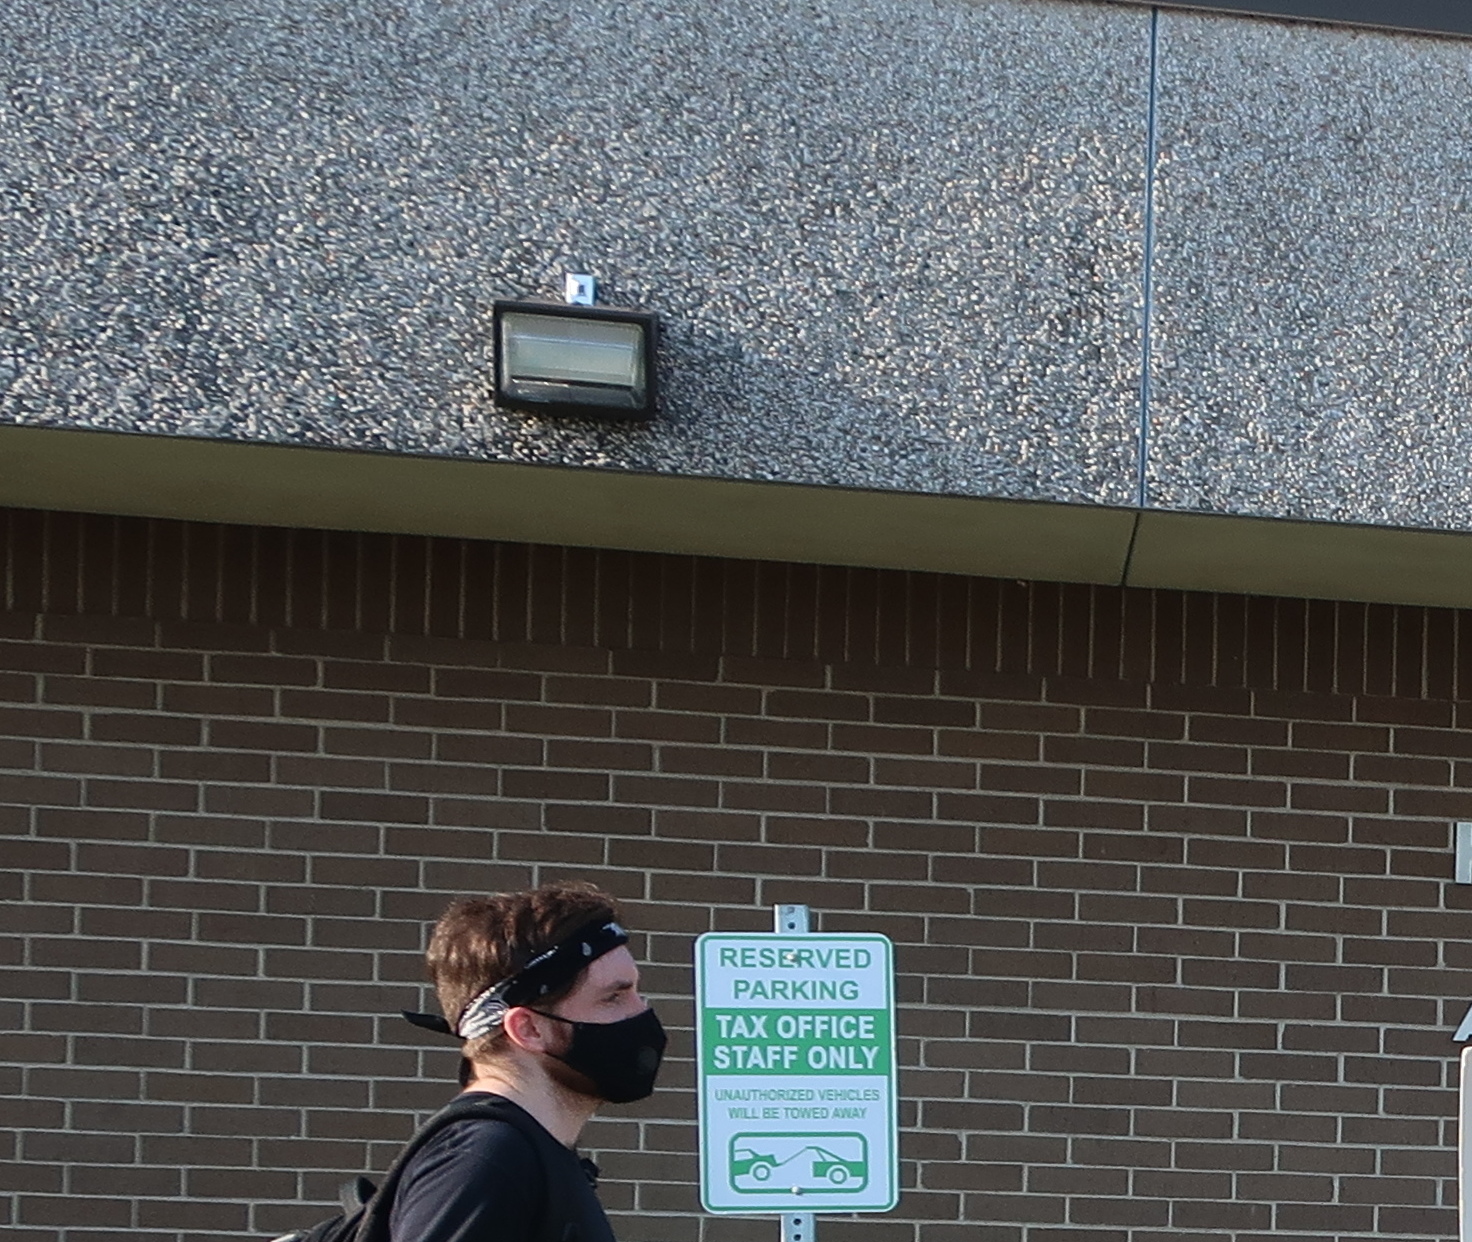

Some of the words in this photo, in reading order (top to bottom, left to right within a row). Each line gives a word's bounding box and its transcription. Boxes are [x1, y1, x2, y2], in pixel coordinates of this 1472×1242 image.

[720, 947, 871, 968] RESERVED
[734, 980, 859, 1000] PARKING
[715, 1015, 768, 1038] TAX
[777, 1015, 875, 1039] OFFICE
[713, 1045, 797, 1069] STAFF
[808, 1046, 879, 1069] ONLY
[715, 1088, 814, 1101] UNAUTHORIZED
[818, 1089, 880, 1101] VEHICLES
[728, 1107, 759, 1119] WILL
[763, 1107, 780, 1119] BE
[784, 1107, 829, 1119] TOWED
[833, 1107, 867, 1119] AWAY
